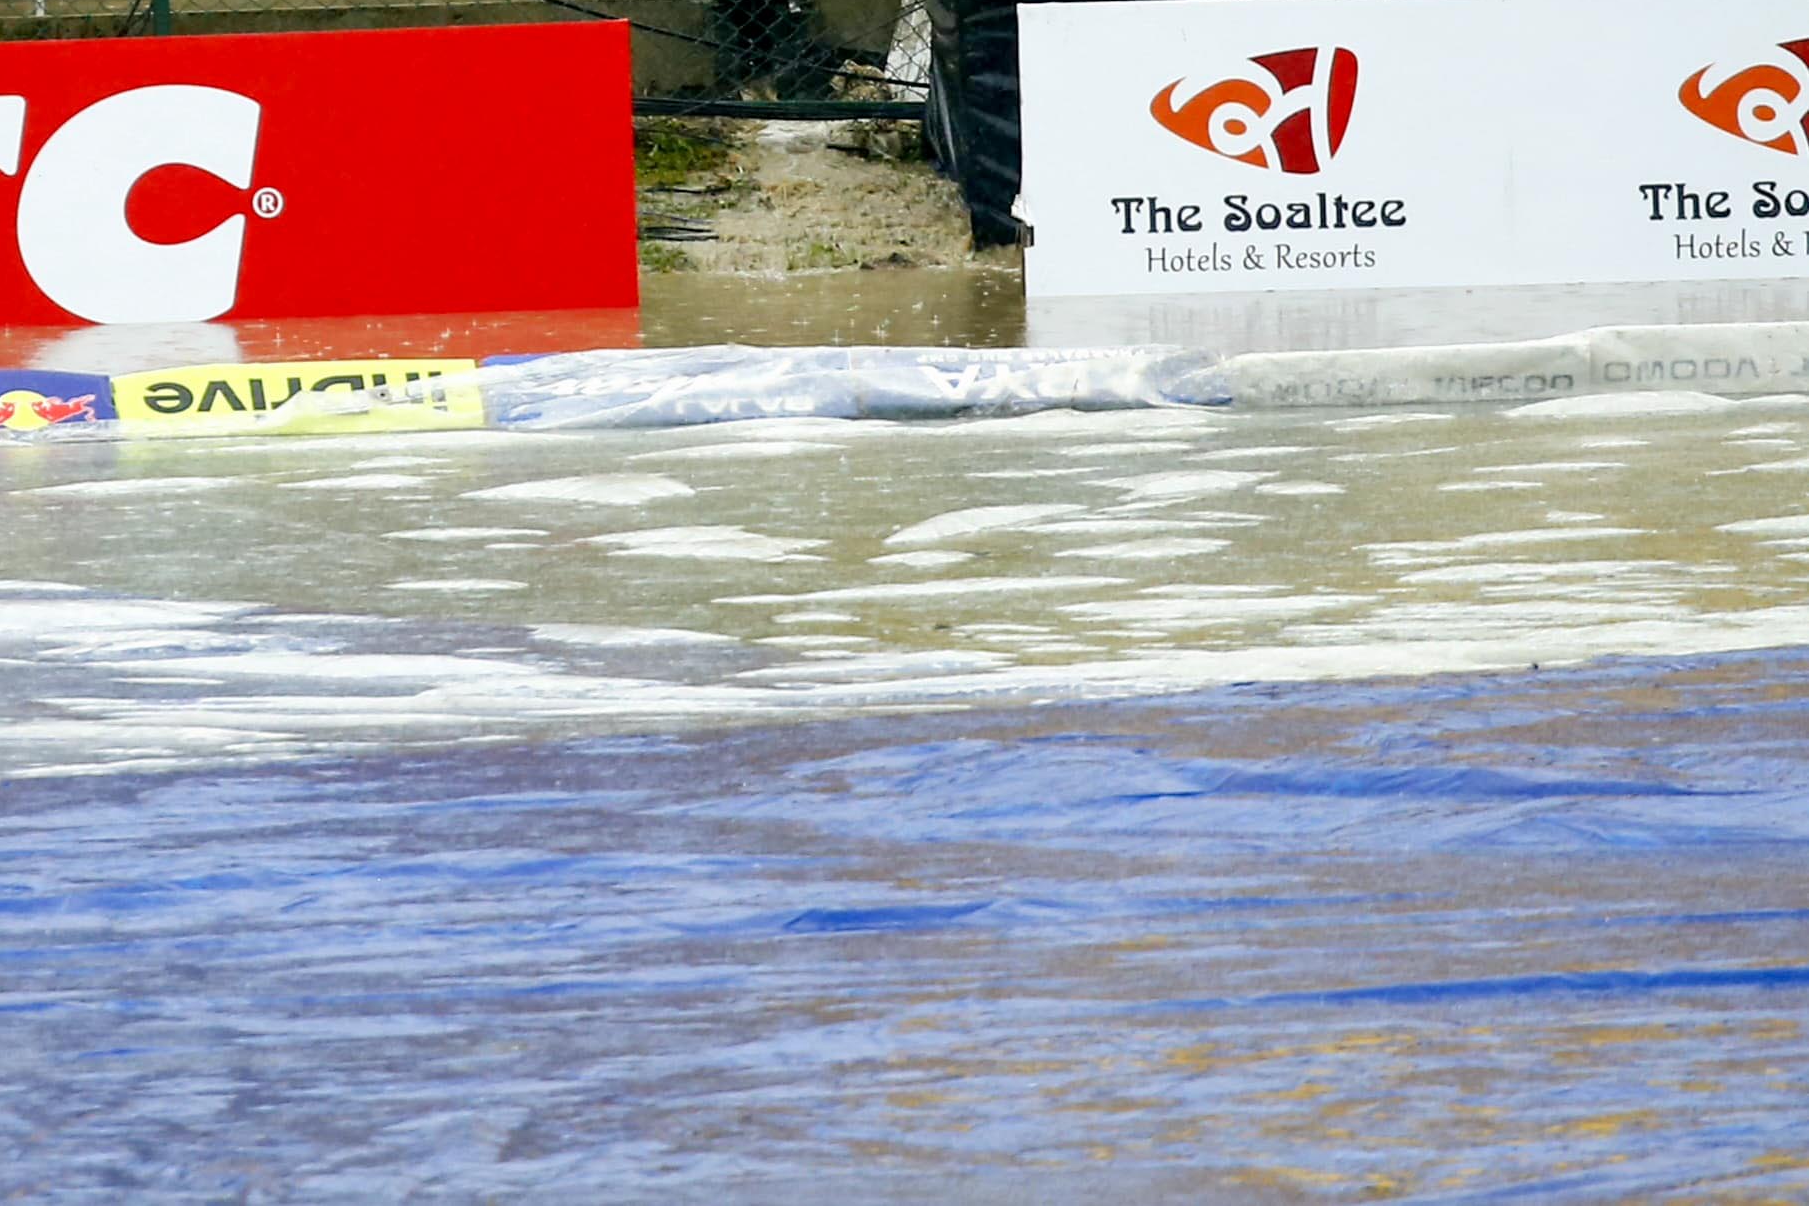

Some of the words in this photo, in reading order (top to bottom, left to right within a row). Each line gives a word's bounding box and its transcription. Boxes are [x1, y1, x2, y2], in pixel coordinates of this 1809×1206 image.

[1111, 196, 1202, 234] The
[1223, 192, 1407, 232] Soaltee
[1639, 183, 1731, 220] The
[1146, 244, 1232, 273] Hotels
[1243, 246, 1266, 270] &
[1275, 243, 1376, 270] Resorts
[1674, 230, 1762, 260] Hotels
[1771, 233, 1795, 257] &
[1604, 356, 1760, 382] OMODA
